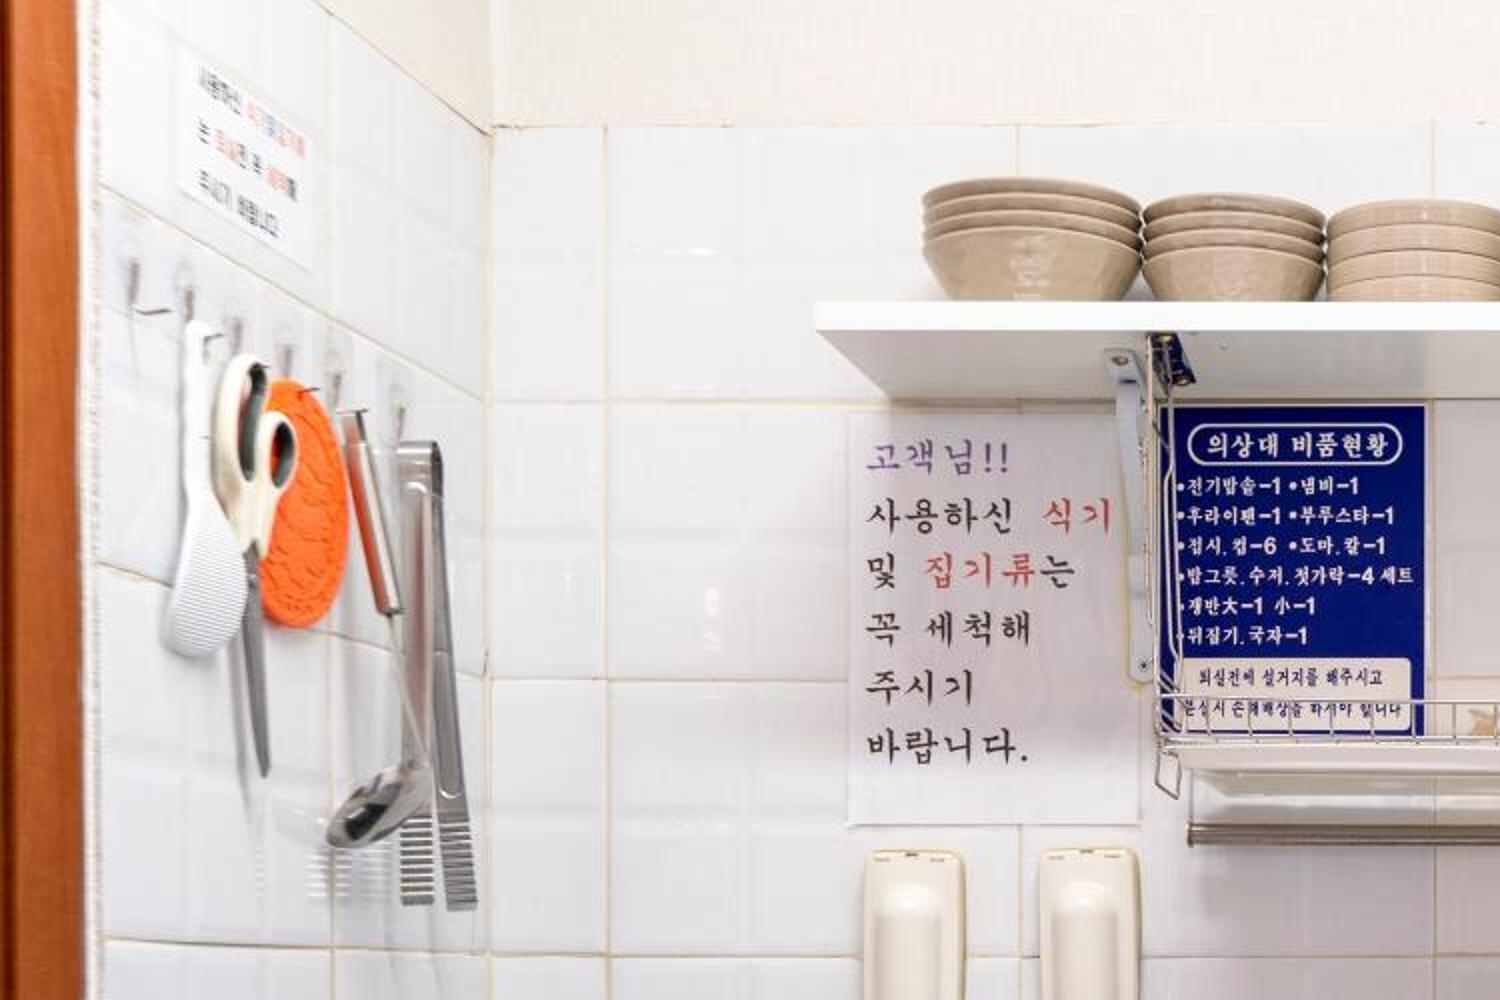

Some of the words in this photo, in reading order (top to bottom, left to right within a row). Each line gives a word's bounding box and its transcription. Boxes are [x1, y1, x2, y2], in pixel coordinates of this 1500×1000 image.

[866, 439, 1009, 476] 고객님!!
[1207, 431, 1279, 459] 의상대
[1291, 431, 1389, 459] 비품현황
[866, 497, 1012, 536] 사용하신
[1043, 497, 1113, 535] 식기
[866, 551, 897, 589] 및
[925, 550, 1075, 589] 집기류는
[865, 612, 901, 649] 꼭
[925, 610, 1031, 648] 세척해
[865, 669, 974, 706] 주시기
[866, 727, 1029, 766] 바랍니다.
